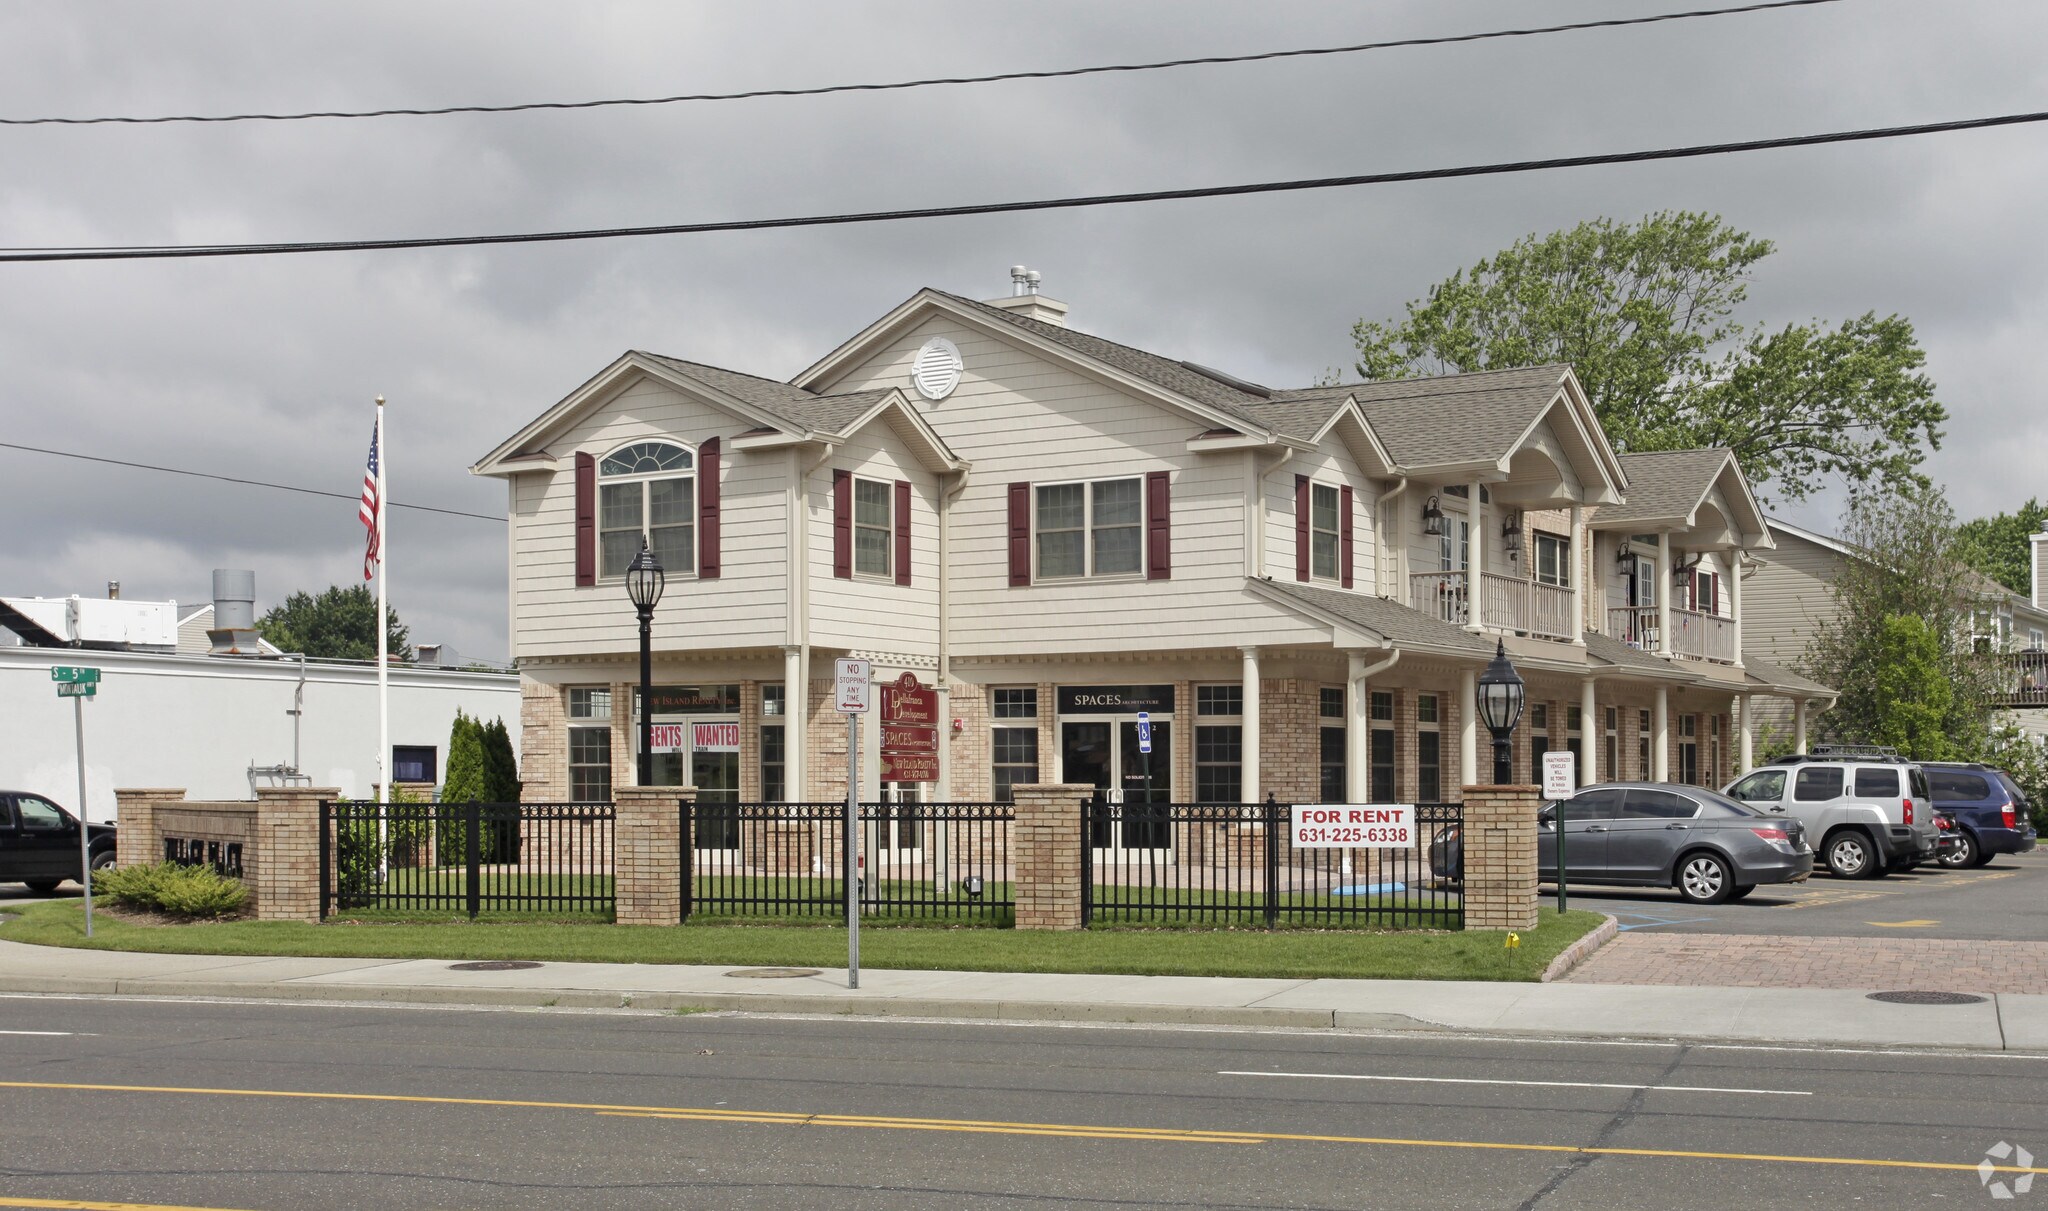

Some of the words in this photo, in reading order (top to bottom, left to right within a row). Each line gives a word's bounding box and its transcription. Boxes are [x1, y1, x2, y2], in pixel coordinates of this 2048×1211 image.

[53, 667, 59, 678] S
[847, 664, 859, 674] NO
[662, 695, 690, 705] ISLAND
[1074, 694, 1121, 706] SPACES
[650, 725, 682, 747] GENTS
[695, 725, 739, 746] WANTED
[886, 732, 912, 746] SPACES
[1302, 810, 1341, 823] FOR
[1349, 810, 1404, 823] RENT
[1299, 828, 1408, 842] 631-225-6338
